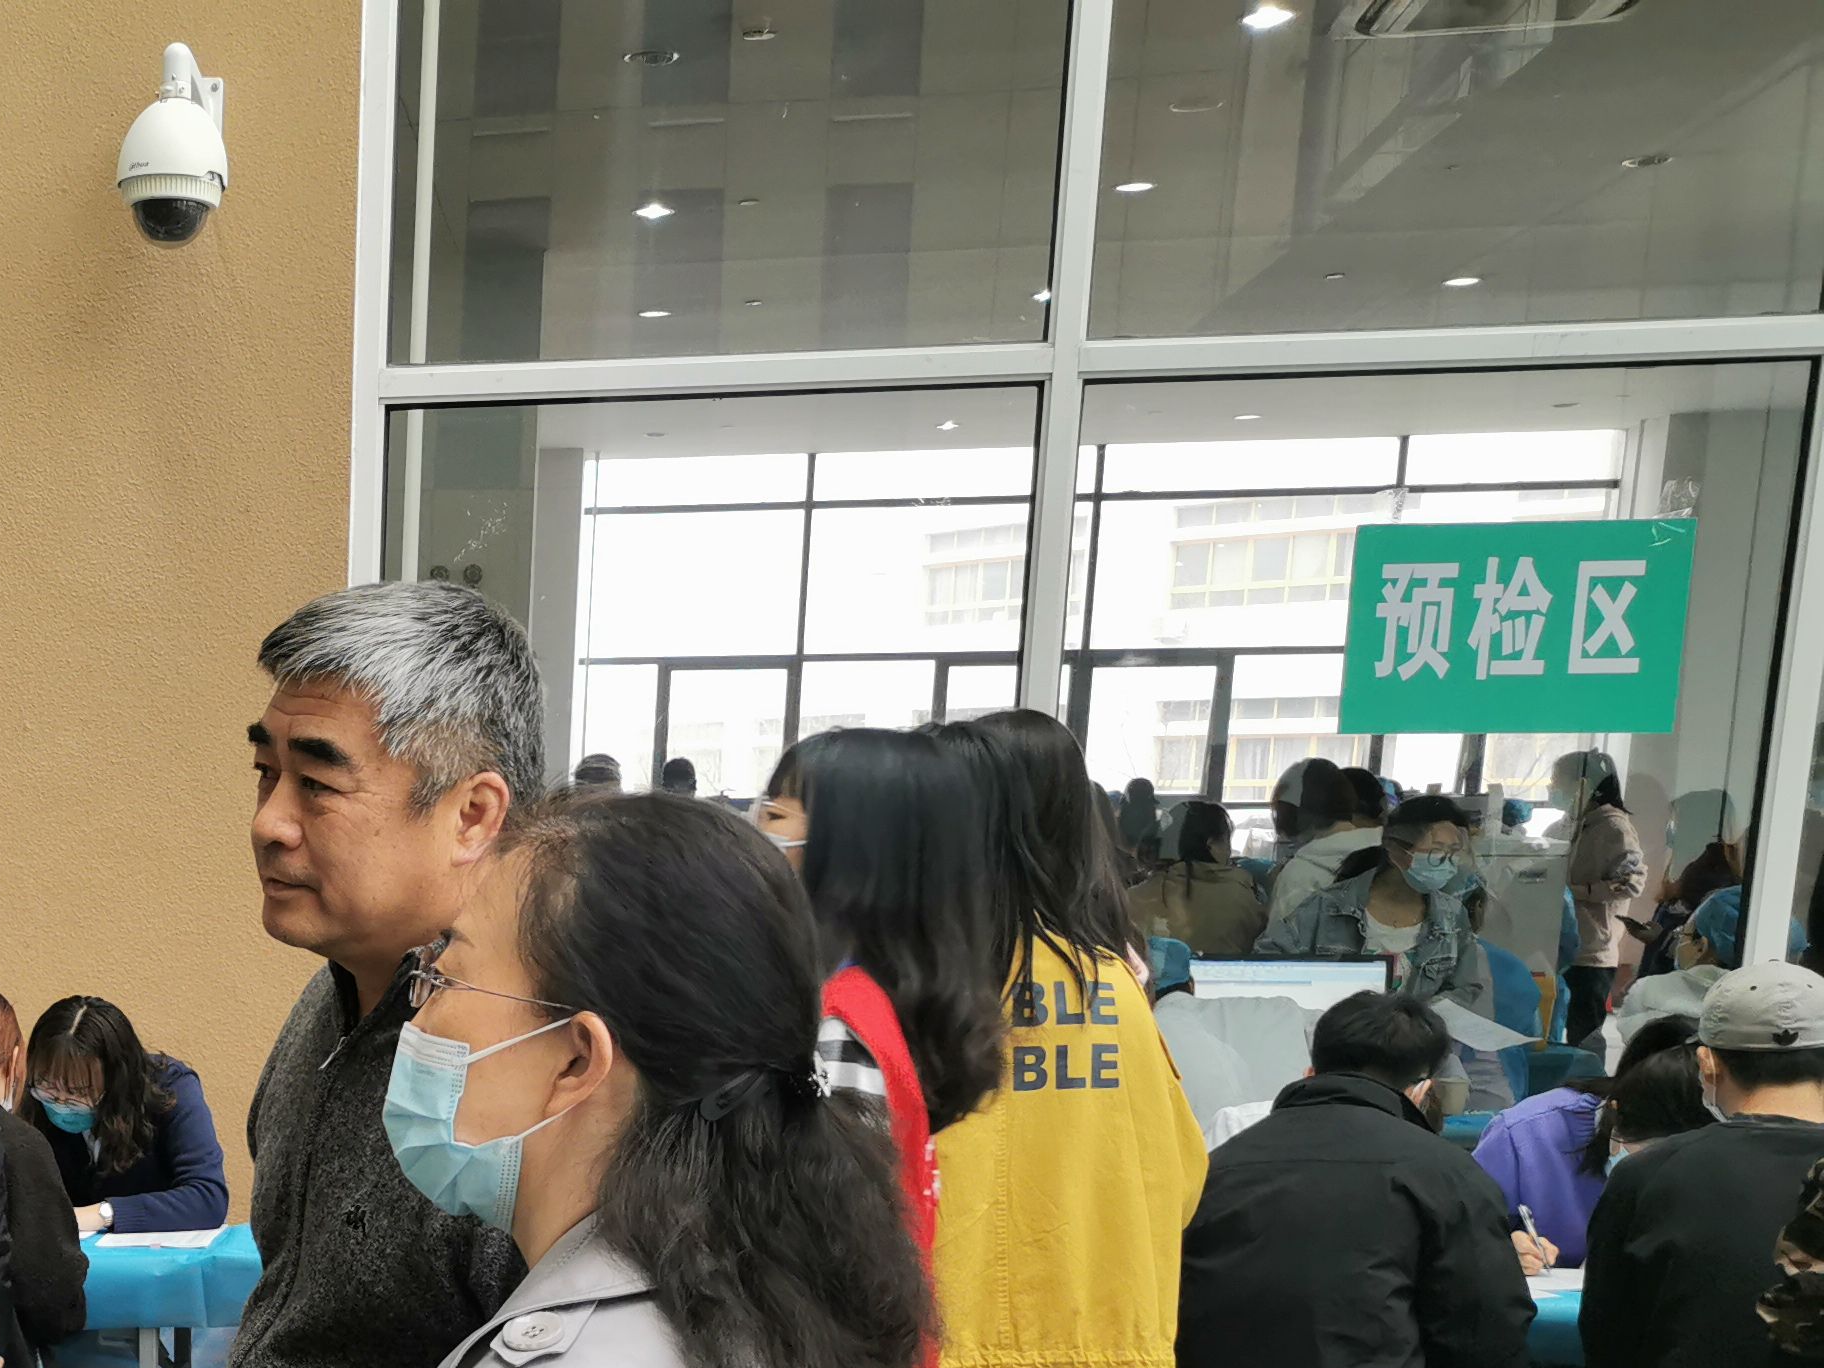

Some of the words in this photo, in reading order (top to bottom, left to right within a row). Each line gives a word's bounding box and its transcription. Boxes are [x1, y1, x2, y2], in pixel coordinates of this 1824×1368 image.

[1374, 556, 1647, 681] 预检区
[1011, 981, 1119, 1027] BLE
[1012, 1043, 1120, 1091] BLE
